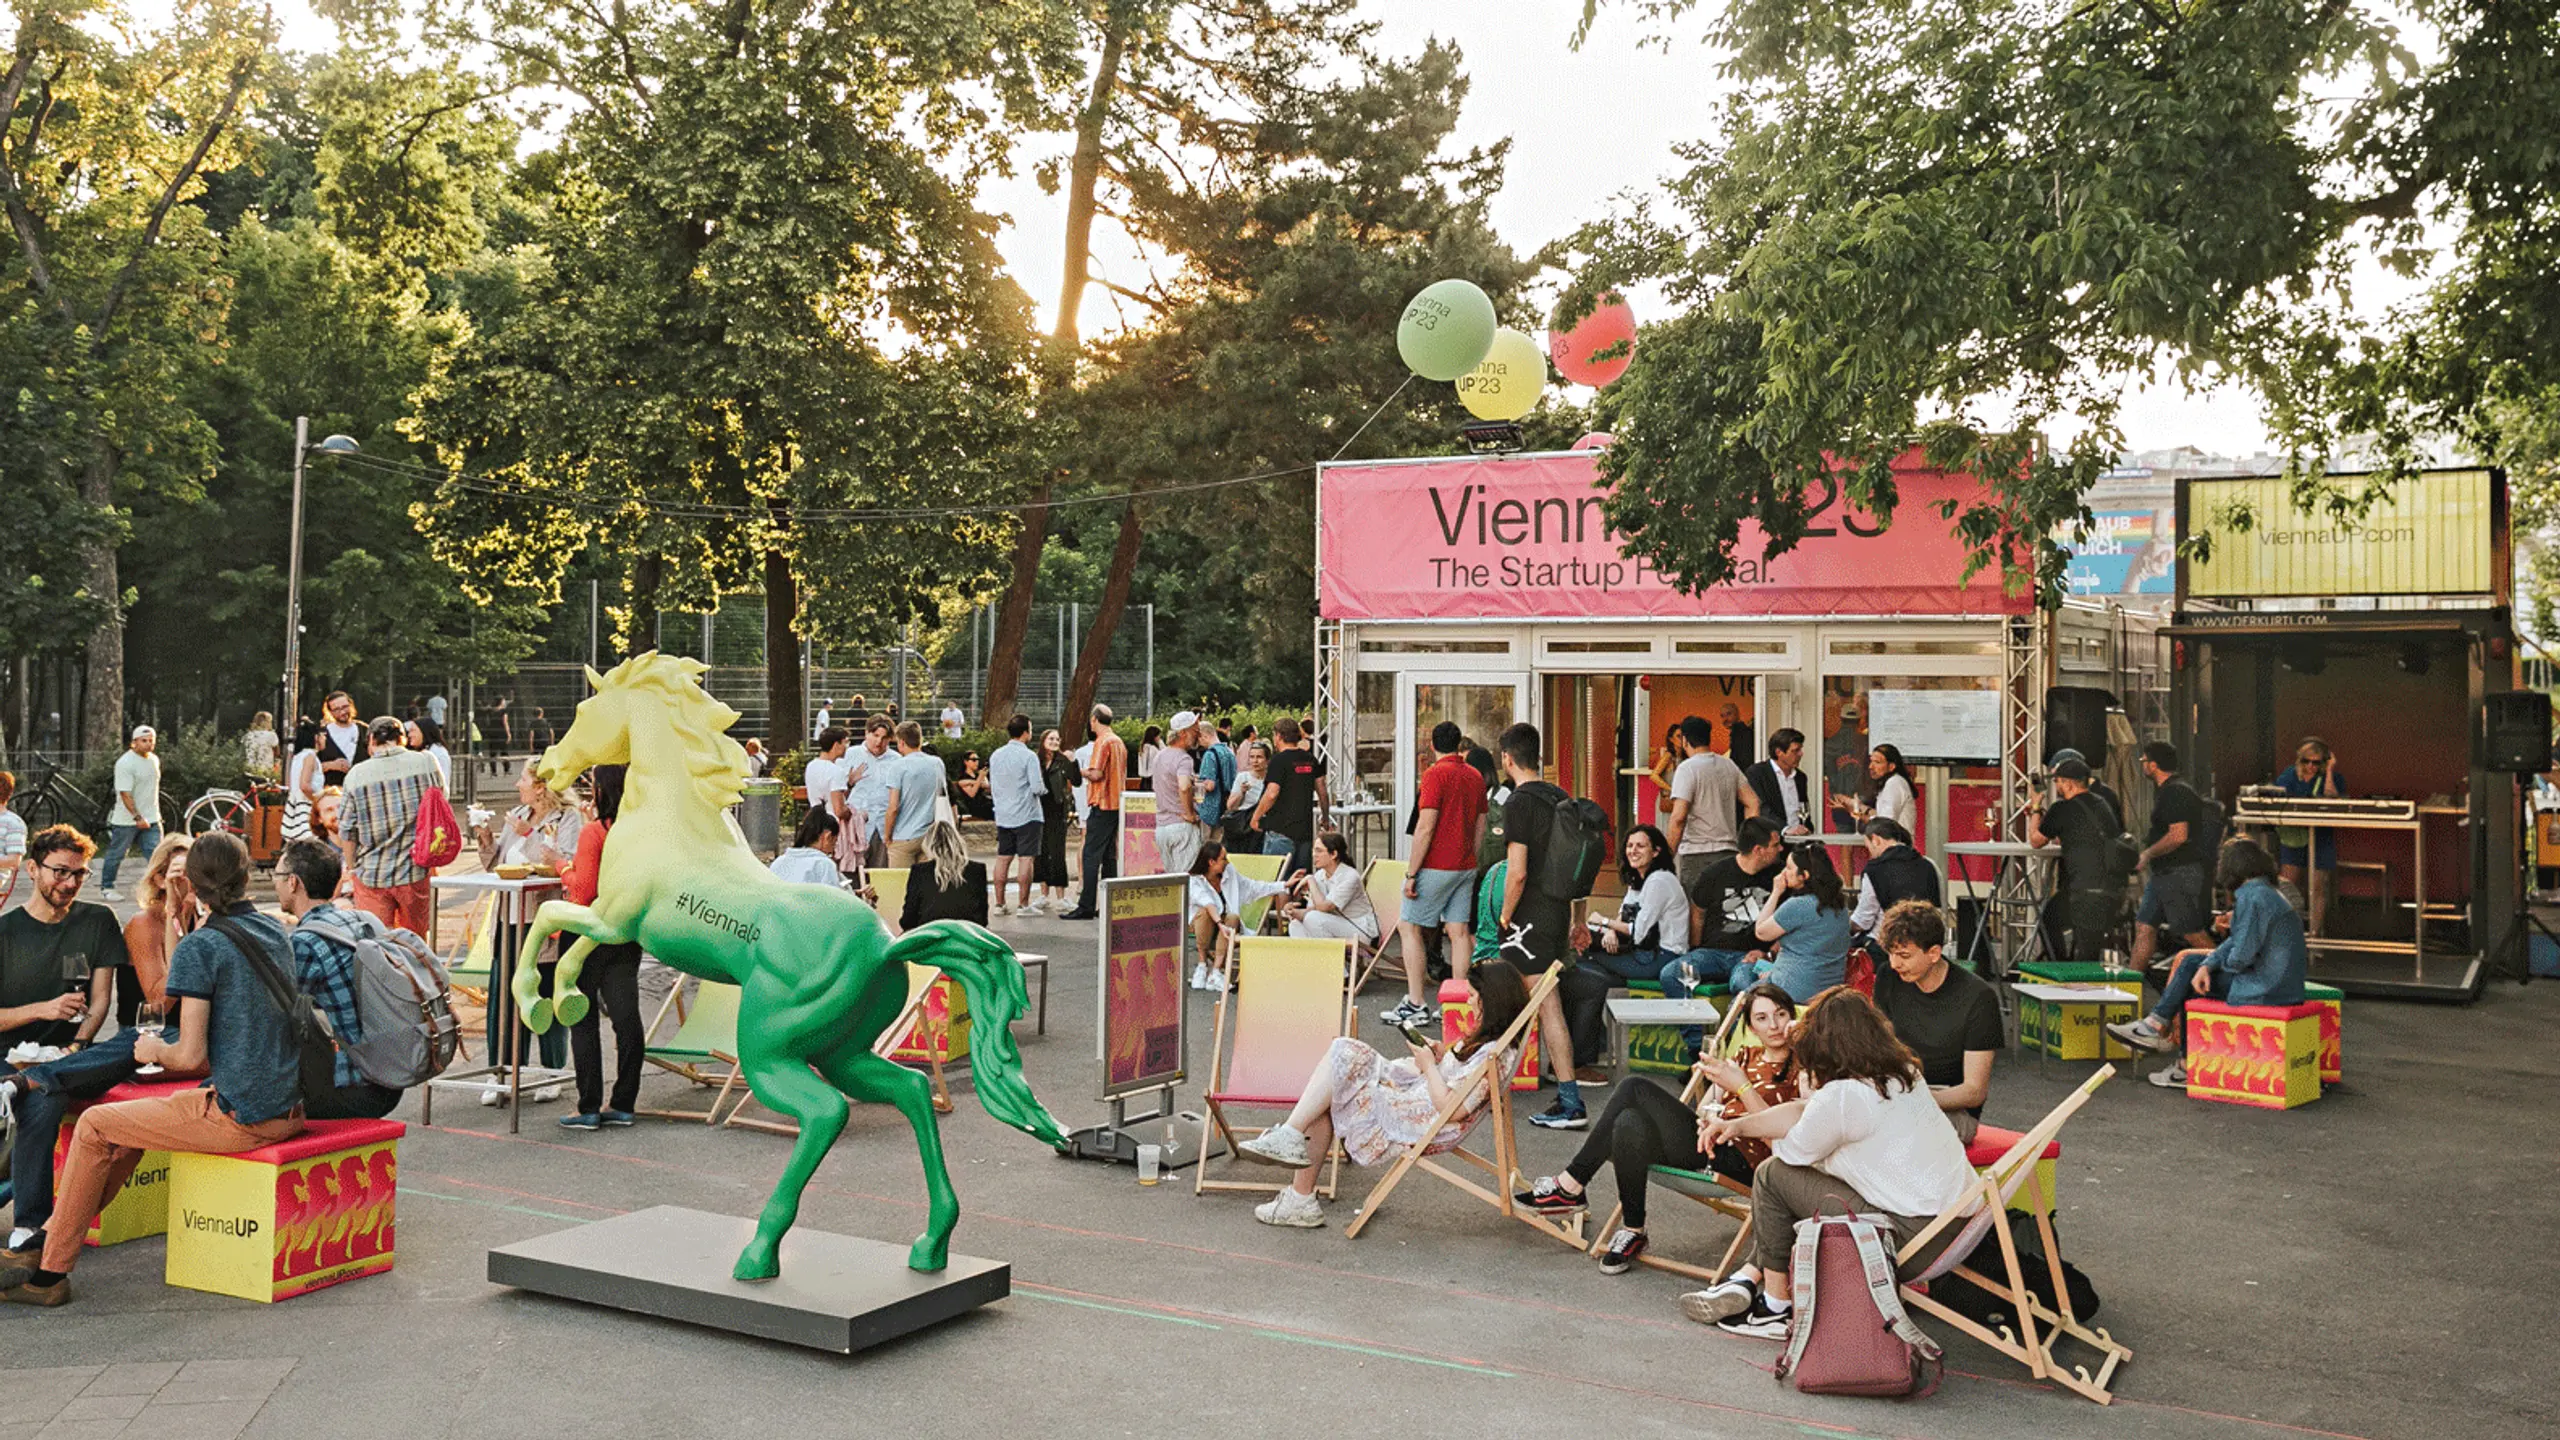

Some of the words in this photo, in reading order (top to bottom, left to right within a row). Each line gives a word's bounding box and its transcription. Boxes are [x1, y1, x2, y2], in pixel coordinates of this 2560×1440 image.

[1417, 297, 1451, 317] enna
[1429, 557, 1490, 588] The
[1500, 556, 1624, 592] Startup
[2072, 1013, 2132, 1026] VienaUP
[183, 1208, 259, 1238] ViennaUP
